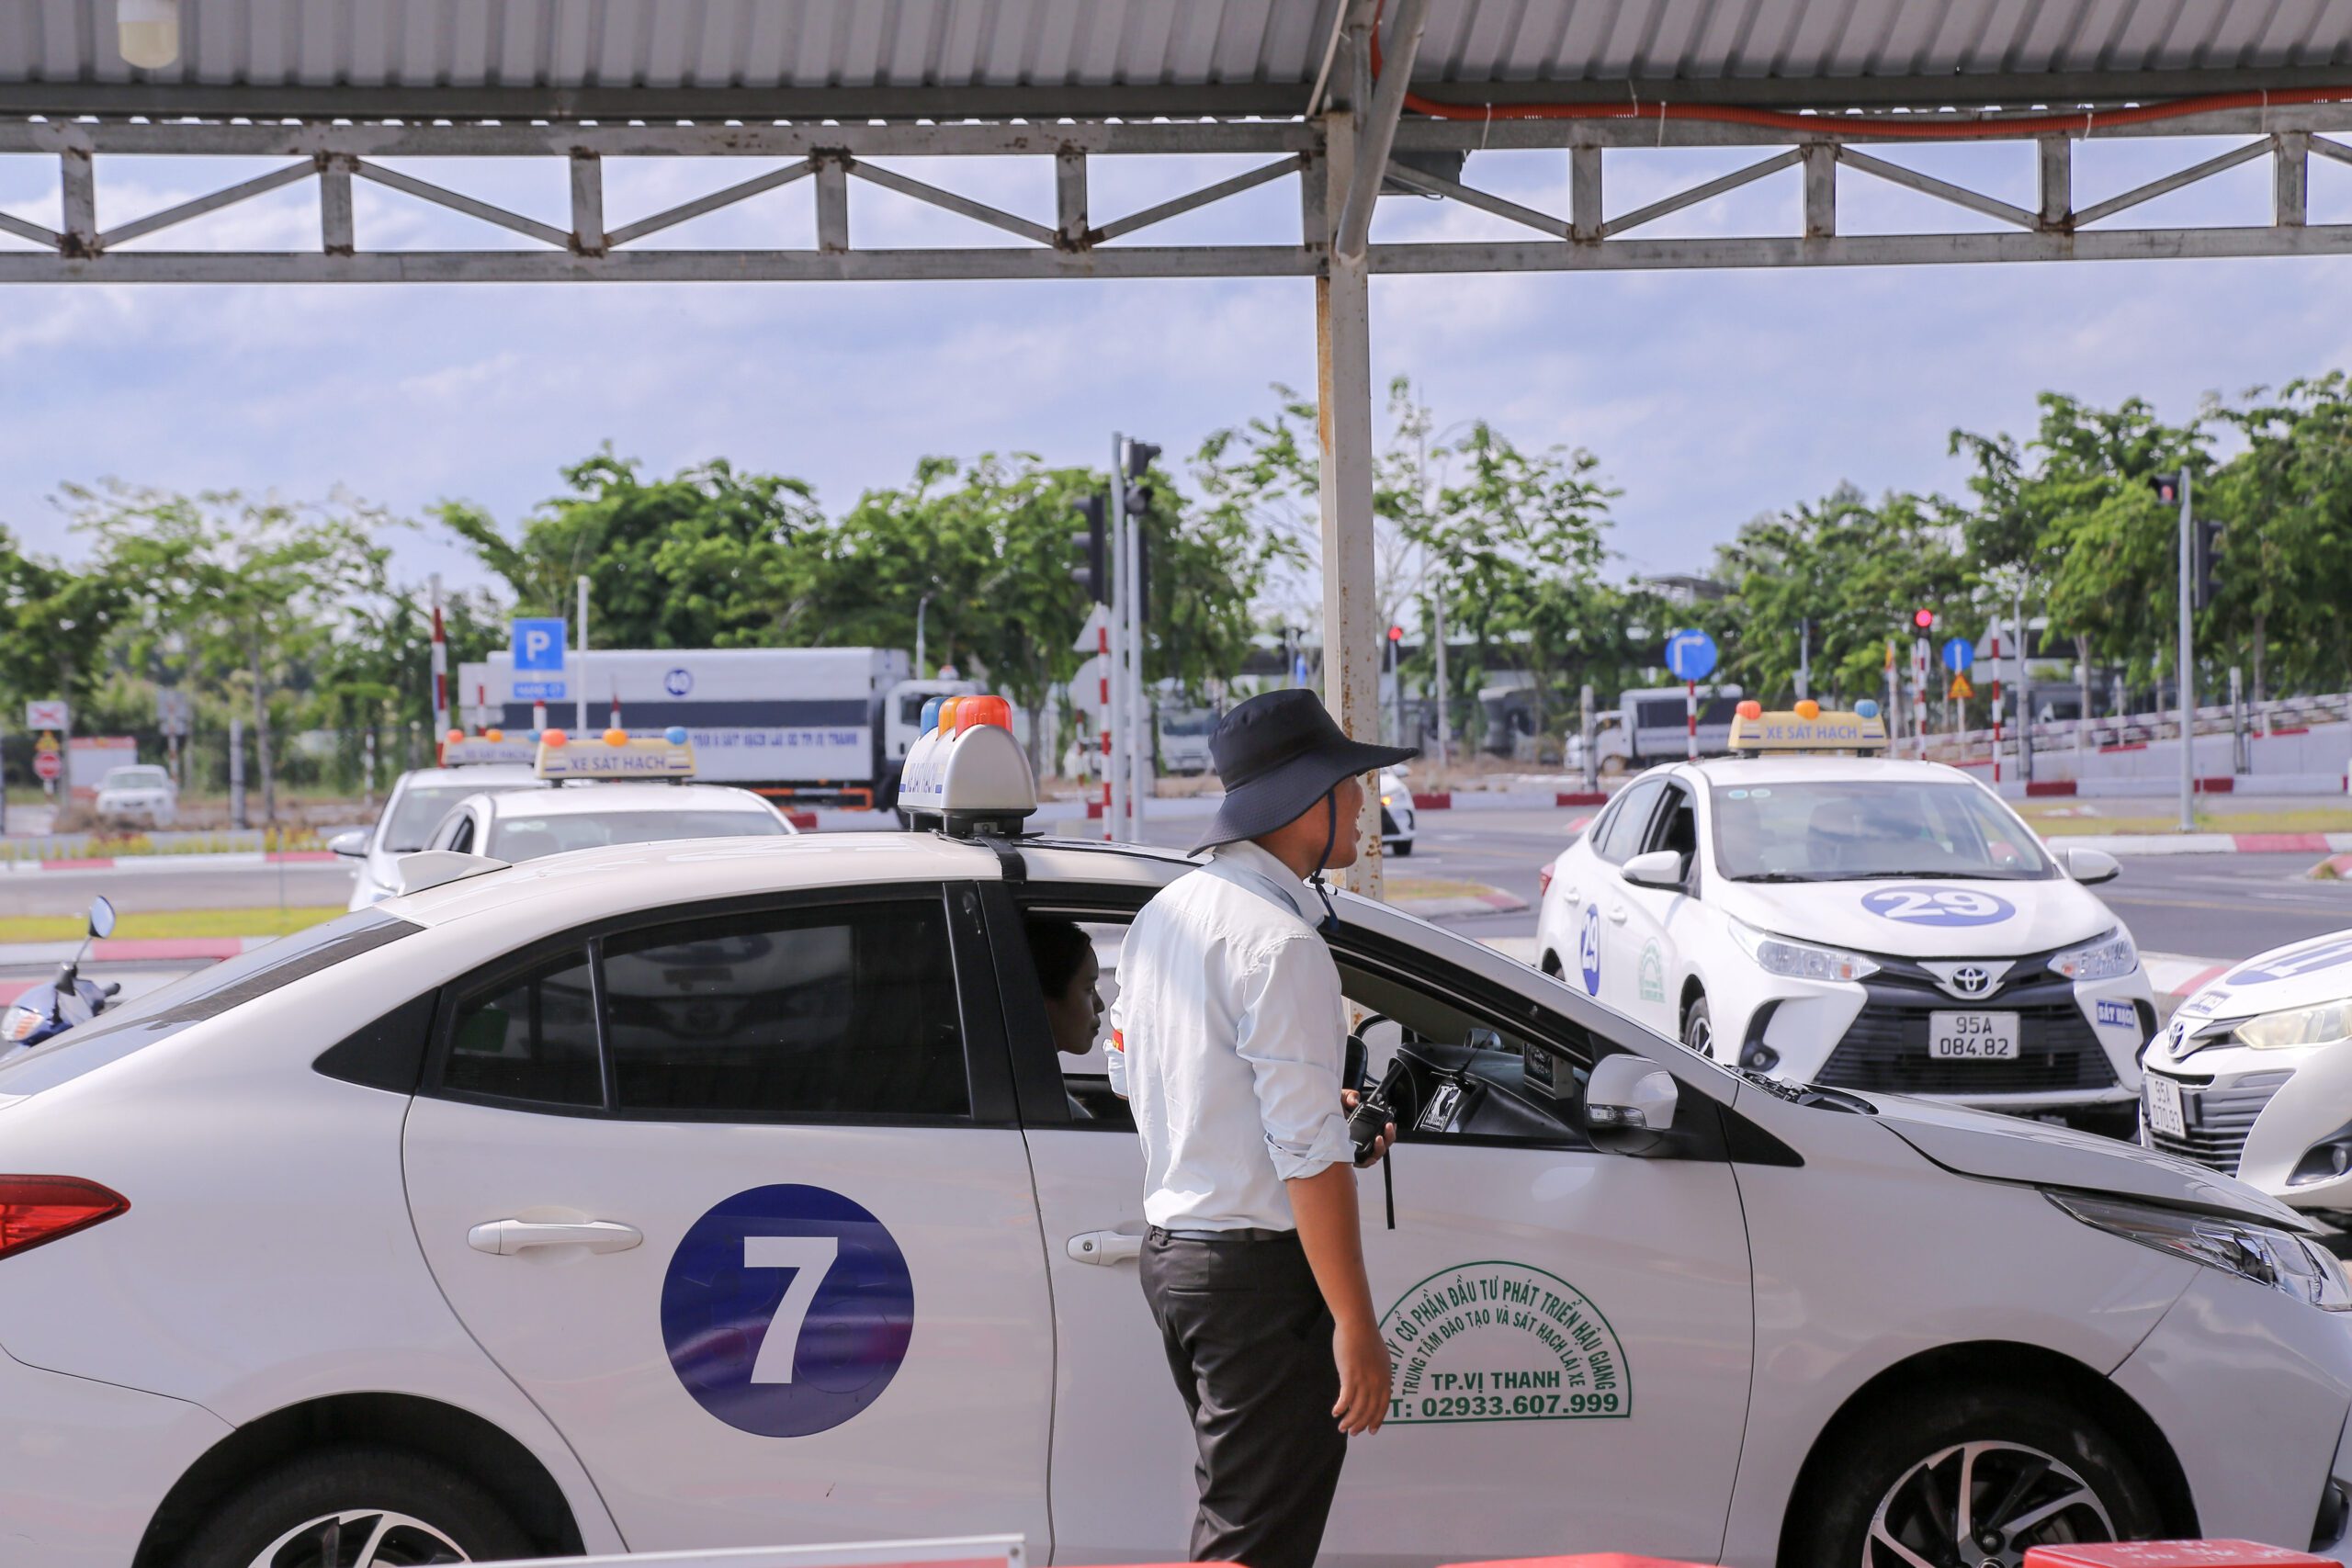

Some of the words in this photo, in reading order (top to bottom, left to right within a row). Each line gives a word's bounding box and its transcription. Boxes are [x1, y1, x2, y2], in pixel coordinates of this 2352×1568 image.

[526, 630, 550, 660] P
[1767, 726, 1783, 739] XE
[1788, 724, 1812, 739] SÁT
[1816, 725, 1858, 741] HẠCH
[571, 757, 587, 771] XE
[1873, 890, 2000, 919] 29
[1582, 912, 1599, 974] 29
[1956, 1016, 1992, 1034] 95A
[1939, 1037, 2009, 1056] 084.82
[744, 1236, 838, 1383] 7
[1465, 1308, 1490, 1329] TẠO
[1496, 1304, 1509, 1325] VÀ
[1395, 1311, 1419, 1342] CỔ
[1410, 1289, 1450, 1327] PHẦN
[1447, 1274, 1476, 1307] ĐẦU
[1479, 1275, 1498, 1301] TƯ
[1502, 1279, 1541, 1307] PHÁT
[1540, 1292, 1583, 1329] TRIỂN
[1571, 1321, 1603, 1352] HẬU
[1589, 1350, 1617, 1391] GIANG
[1439, 1317, 1465, 1339] ĐÀO
[1512, 1311, 1538, 1332] SÁT
[1417, 1331, 1443, 1358] TÂM
[1536, 1323, 1568, 1353] HẠCH
[1559, 1349, 1584, 1371] LÁI
[1402, 1357, 1427, 1395] TRUNG
[1430, 1372, 1484, 1394] TP.VỊ
[1490, 1371, 1560, 1390] THANH
[1567, 1371, 1586, 1388] XE
[1421, 1393, 1620, 1417] 02933.607.999
